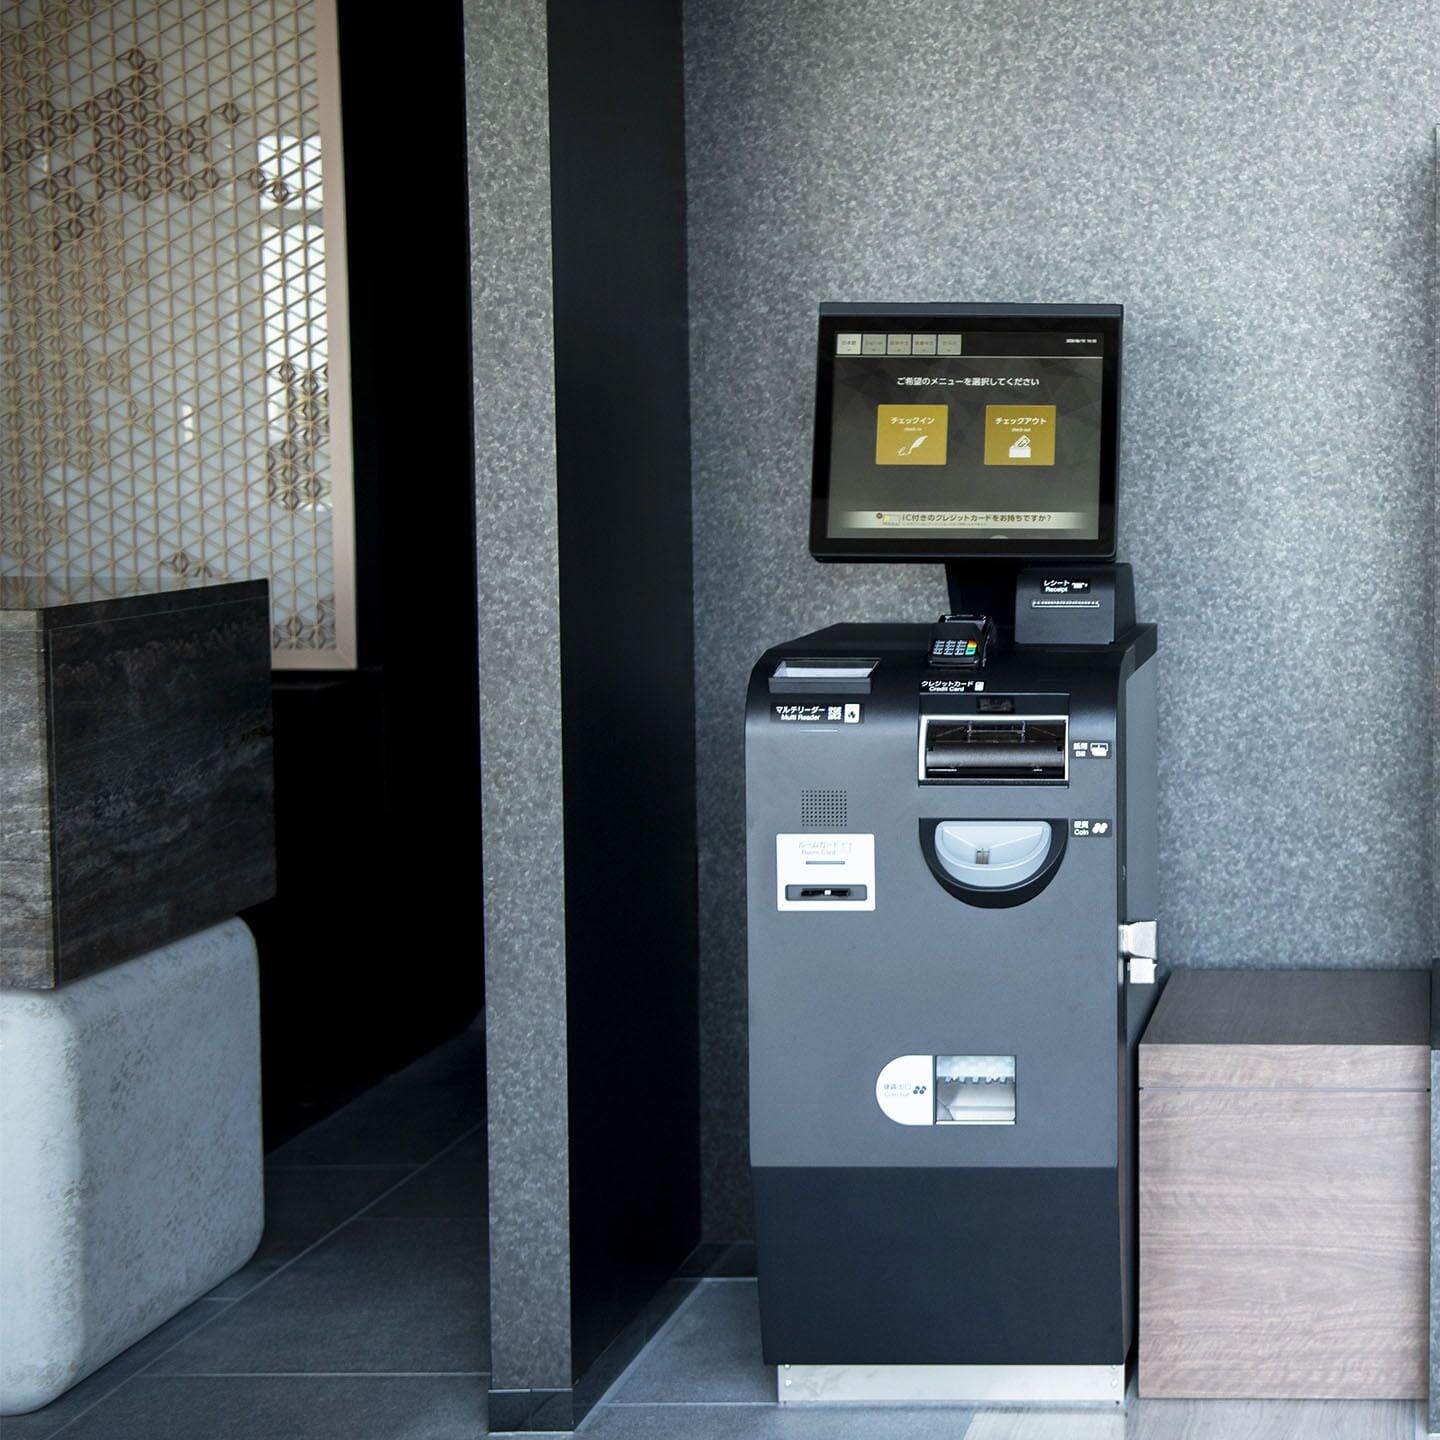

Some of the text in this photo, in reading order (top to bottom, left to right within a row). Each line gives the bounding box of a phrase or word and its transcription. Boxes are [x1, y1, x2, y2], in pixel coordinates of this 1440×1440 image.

[896, 377, 1040, 386] ご希望のメニューを選択してください
[890, 416, 935, 425] チェックイン
[995, 416, 1047, 425] チェックアウト
[1043, 579, 1070, 587] レシート
[775, 706, 825, 714] マルチリーダー
